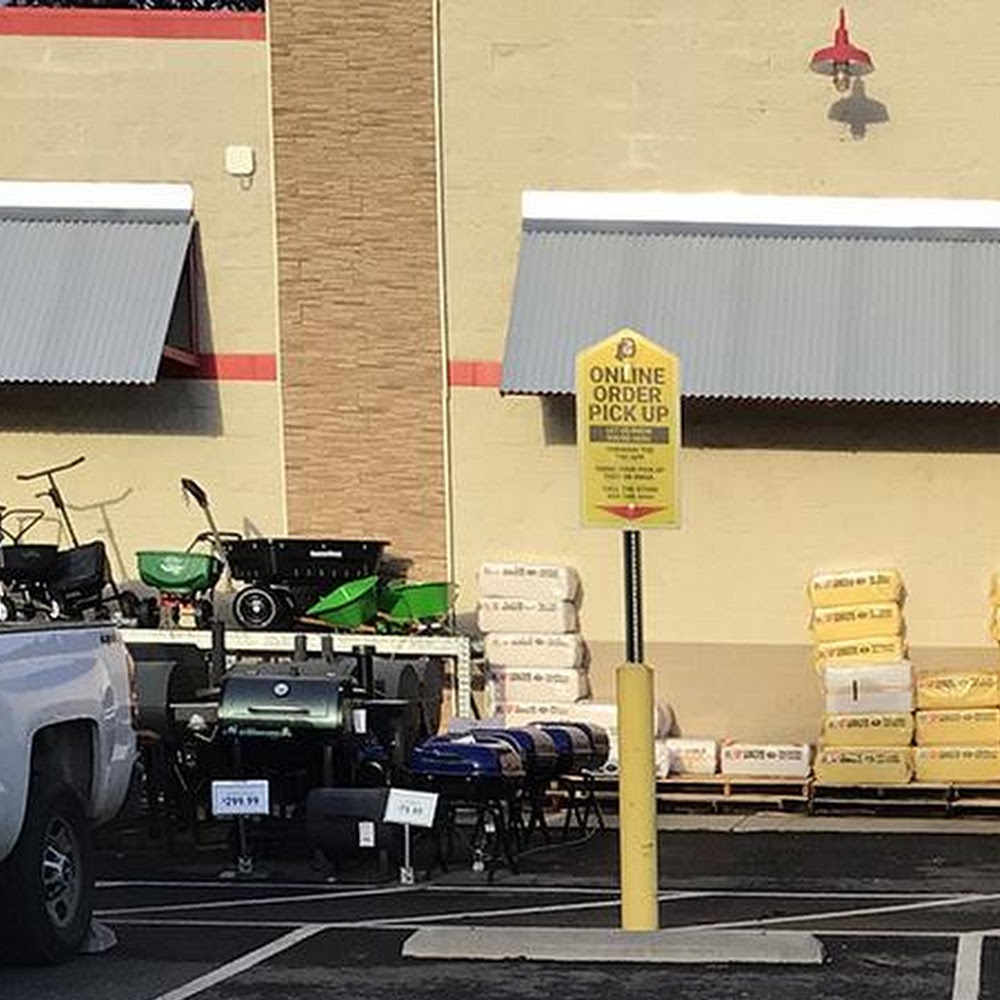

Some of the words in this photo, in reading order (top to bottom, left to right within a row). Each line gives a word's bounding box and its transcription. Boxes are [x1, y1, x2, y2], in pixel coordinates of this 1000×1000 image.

[589, 367, 665, 385] ONLINE
[593, 386, 662, 403] ORDER
[588, 404, 637, 422] PICK
[642, 407, 669, 422] UP
